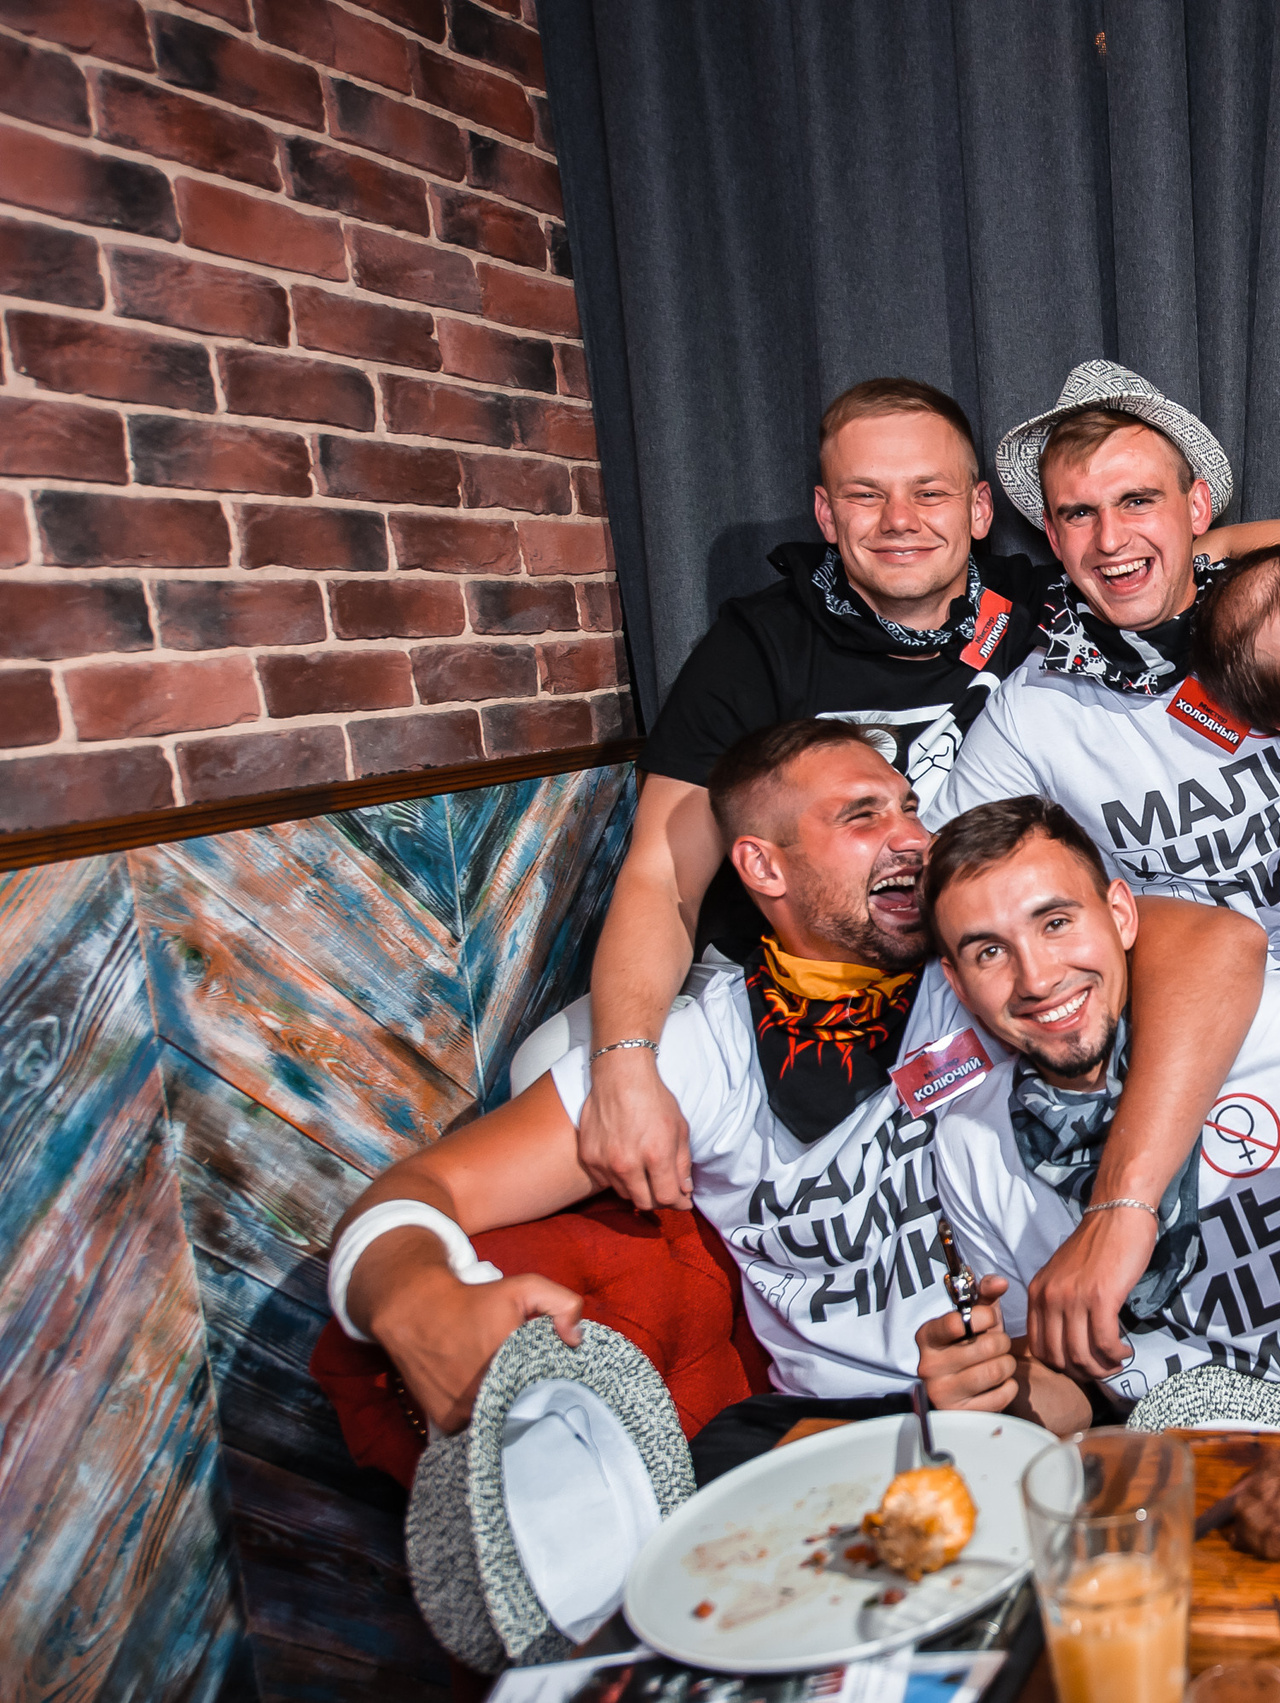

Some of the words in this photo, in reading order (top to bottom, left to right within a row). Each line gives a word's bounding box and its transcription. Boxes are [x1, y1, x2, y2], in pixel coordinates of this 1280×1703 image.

[979, 612, 1010, 659] ЛИПКИЙ
[1176, 698, 1239, 745] ХОЛОДНЫЙ
[913, 1056, 982, 1102] КОЛЮЧИЙ
